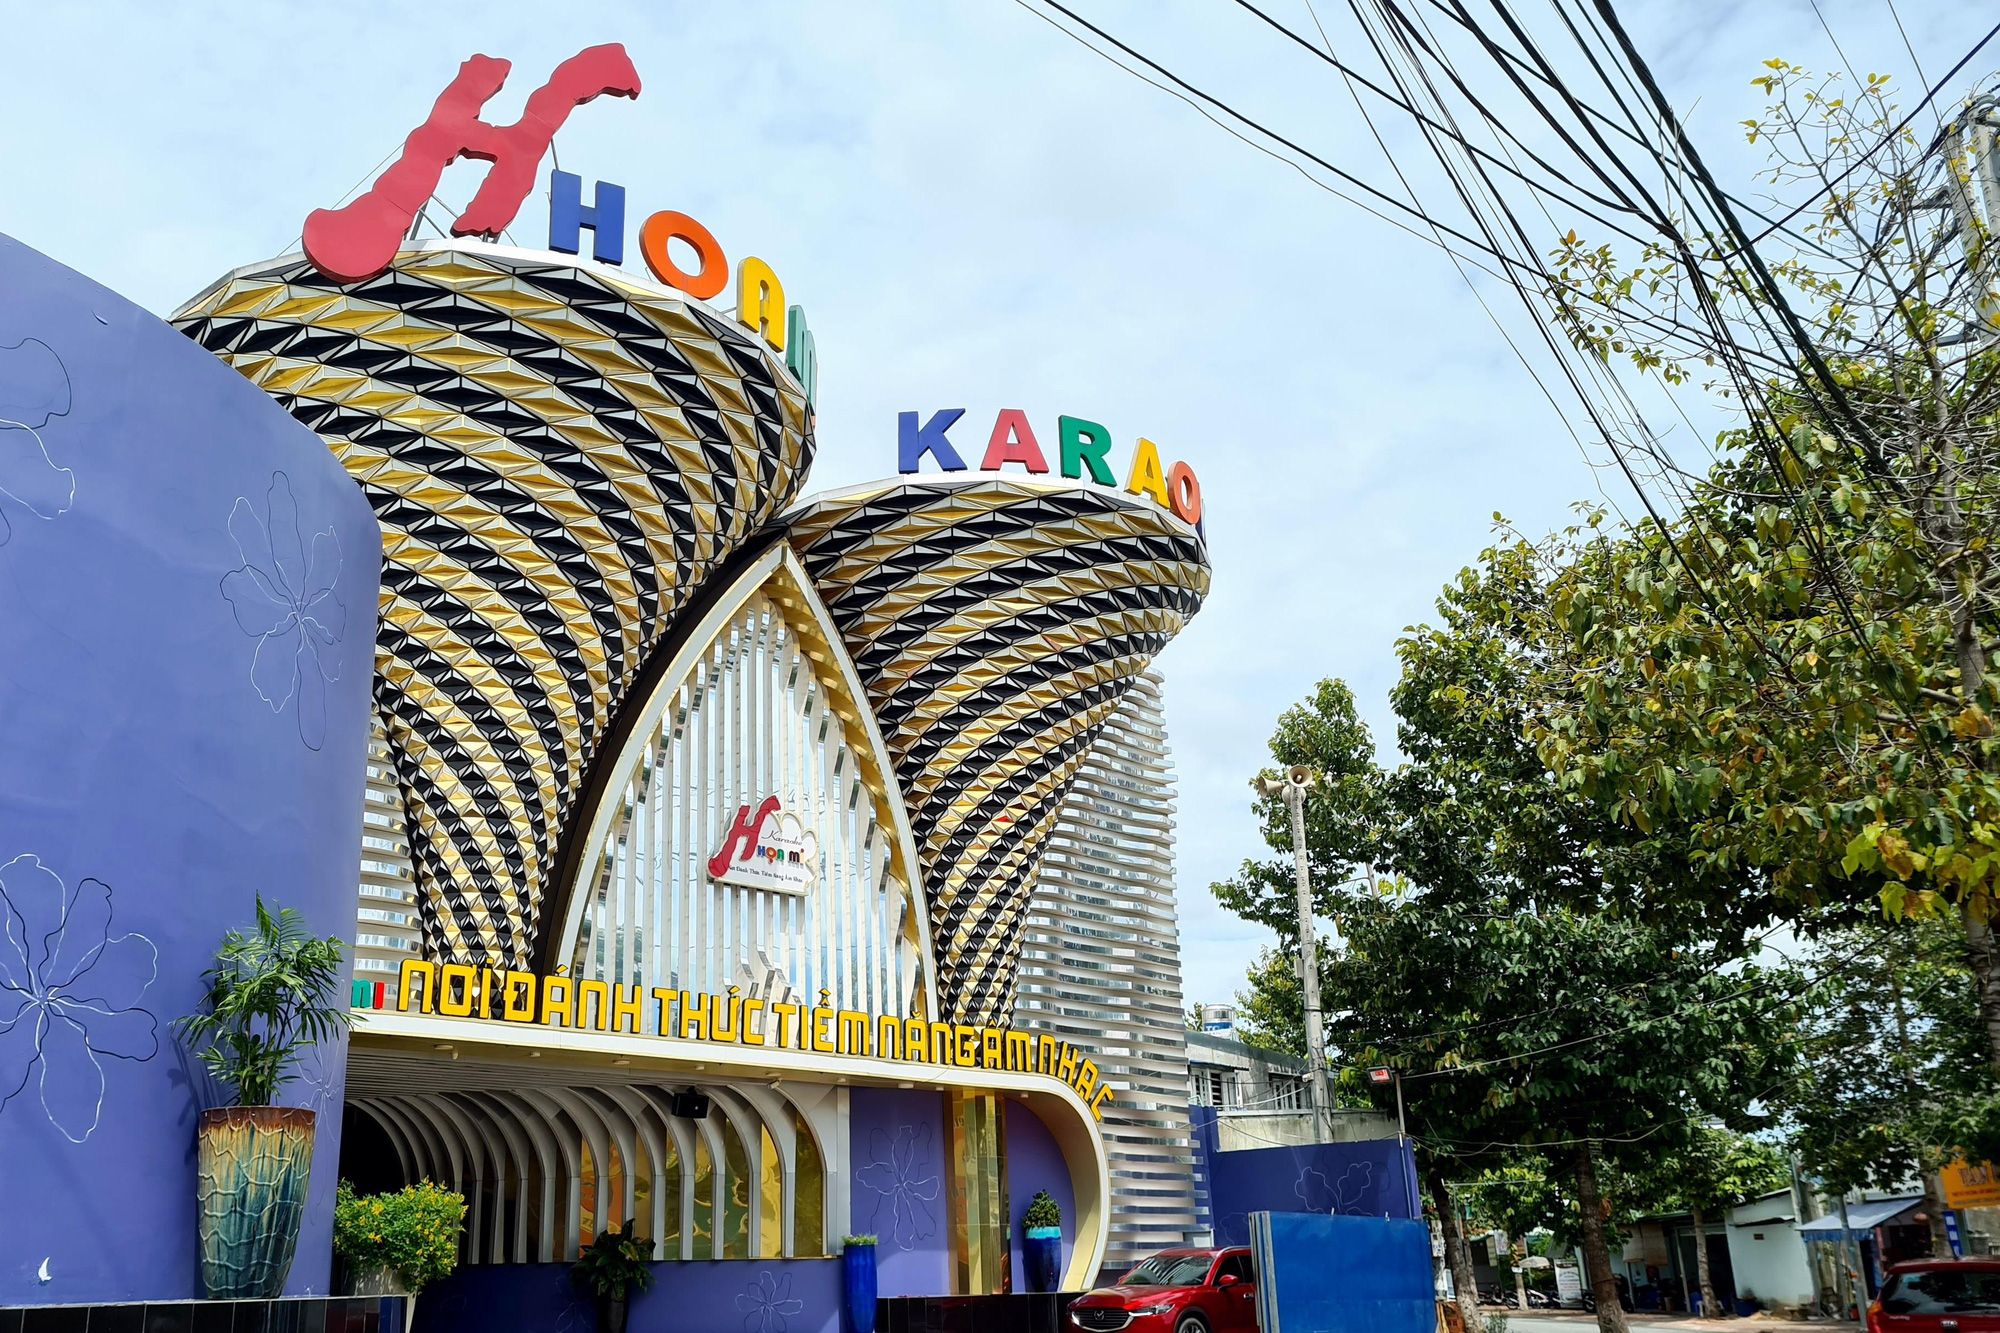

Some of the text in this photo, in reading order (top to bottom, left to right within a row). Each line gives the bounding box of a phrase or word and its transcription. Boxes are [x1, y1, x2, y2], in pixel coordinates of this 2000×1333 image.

[897, 407, 1203, 526] KARAO
[503, 964, 643, 1034] ĐÁNH
[651, 985, 765, 1045] THỨC
[772, 988, 871, 1056] TIỀM
[878, 1010, 977, 1068] NĂNG
[981, 1019, 1032, 1072] ÂM
